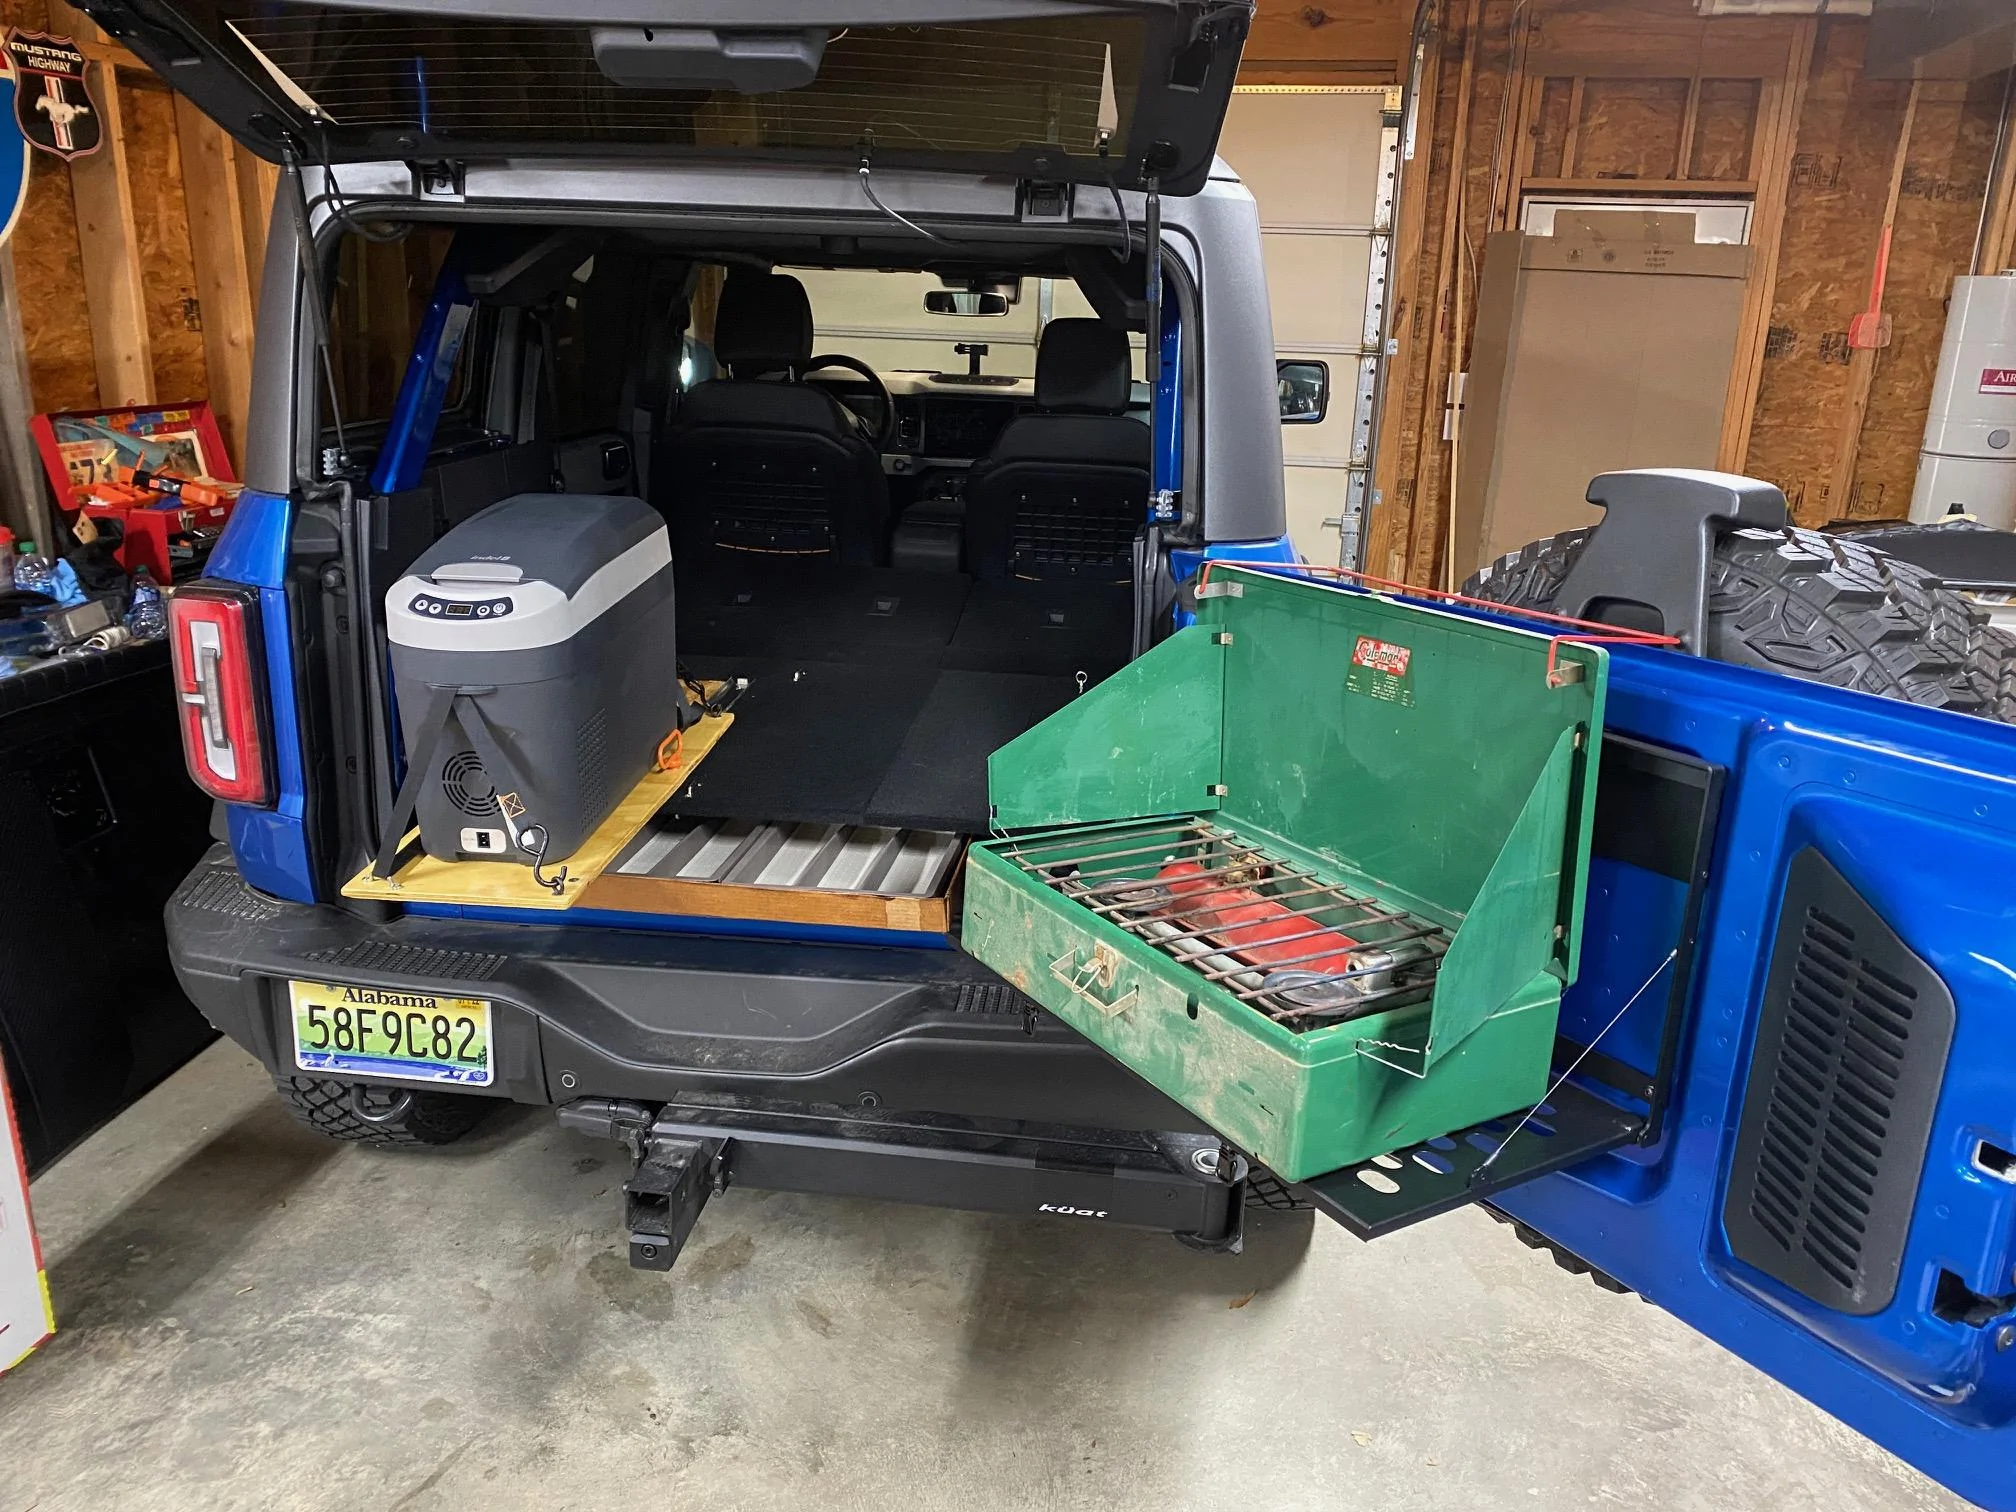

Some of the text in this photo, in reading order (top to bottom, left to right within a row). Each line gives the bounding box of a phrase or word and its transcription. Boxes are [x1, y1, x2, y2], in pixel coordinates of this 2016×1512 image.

[10, 42, 82, 62] MUSTANG
[28, 55, 71, 73] HIGHWAY
[341, 987, 438, 1009] Alabama
[307, 1004, 478, 1063] 58F9C82
